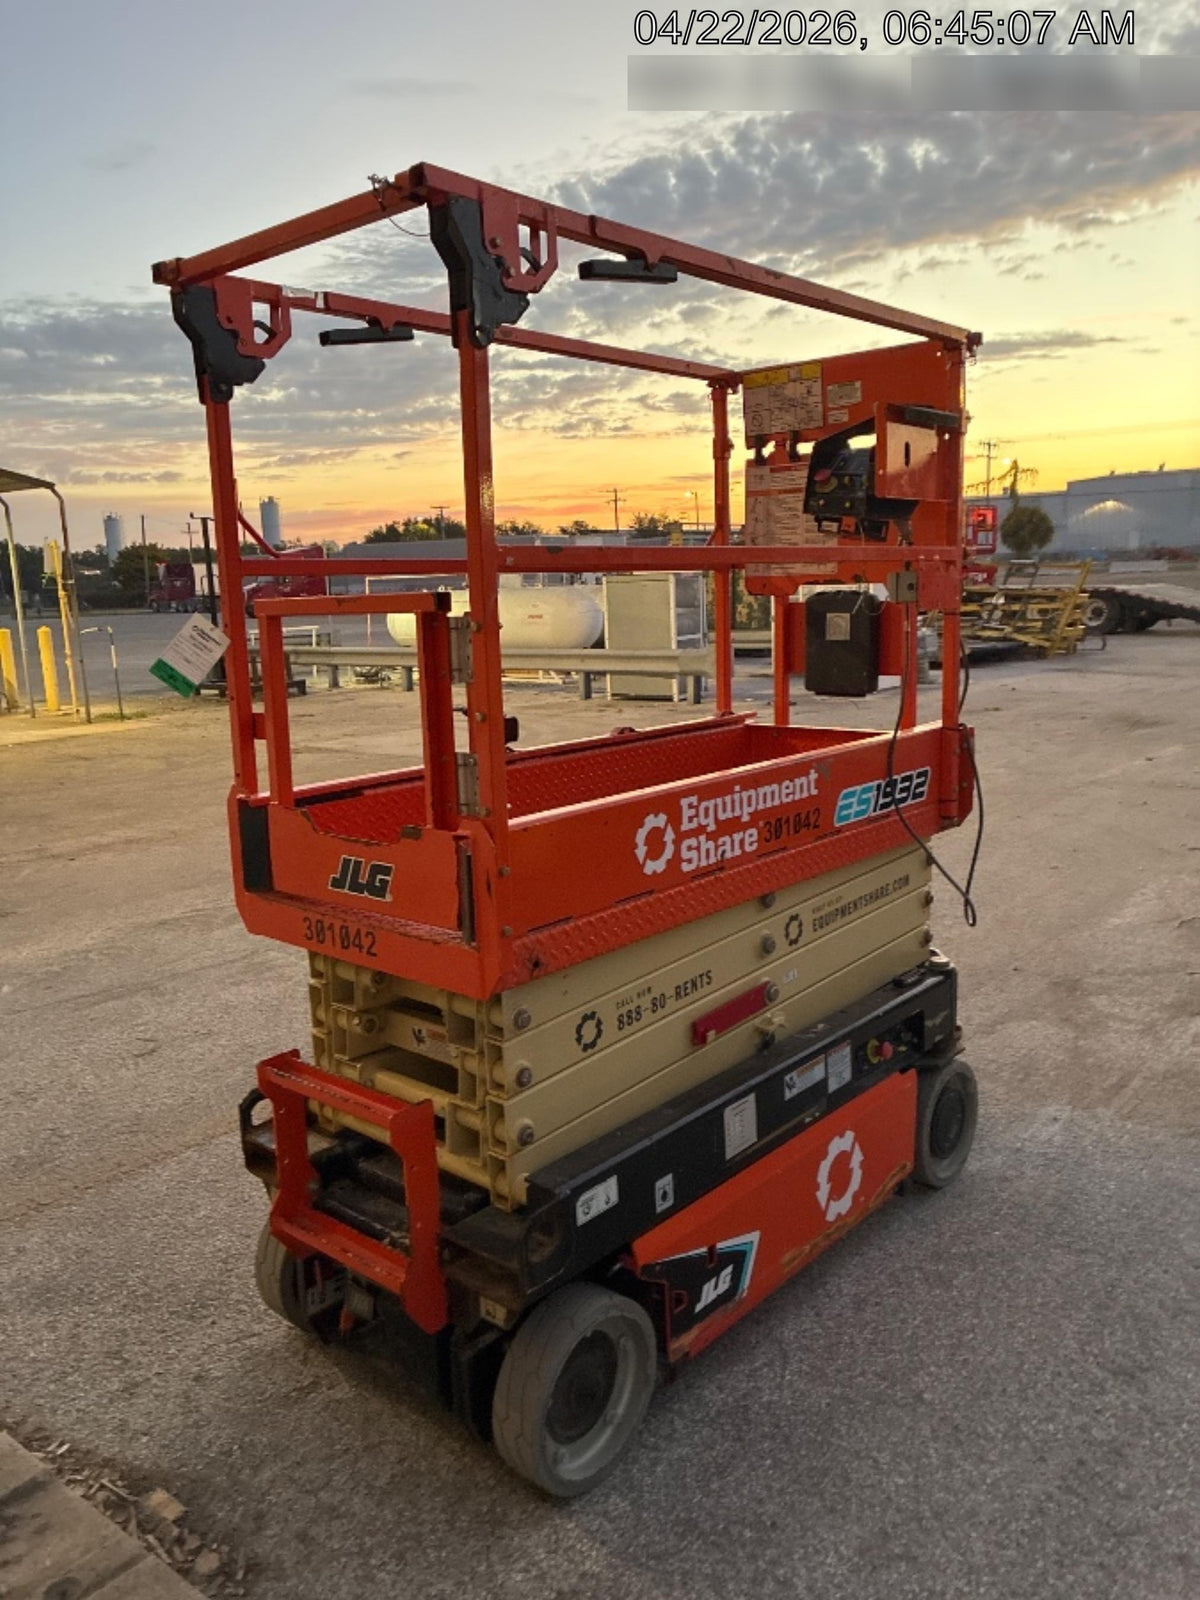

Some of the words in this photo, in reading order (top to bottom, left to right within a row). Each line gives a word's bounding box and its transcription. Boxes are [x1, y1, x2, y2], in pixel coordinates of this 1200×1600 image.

[680, 769, 819, 831] Equipment
[833, 766, 931, 827] ES1932
[680, 827, 759, 873] Share
[763, 807, 821, 844] 301042
[328, 855, 395, 902] JLG
[812, 874, 910, 932] EQUIPMENTSHARE.COM
[303, 916, 378, 958] 301042
[617, 970, 712, 1031] 888-80-RENTS
[694, 1264, 734, 1313] JLG
